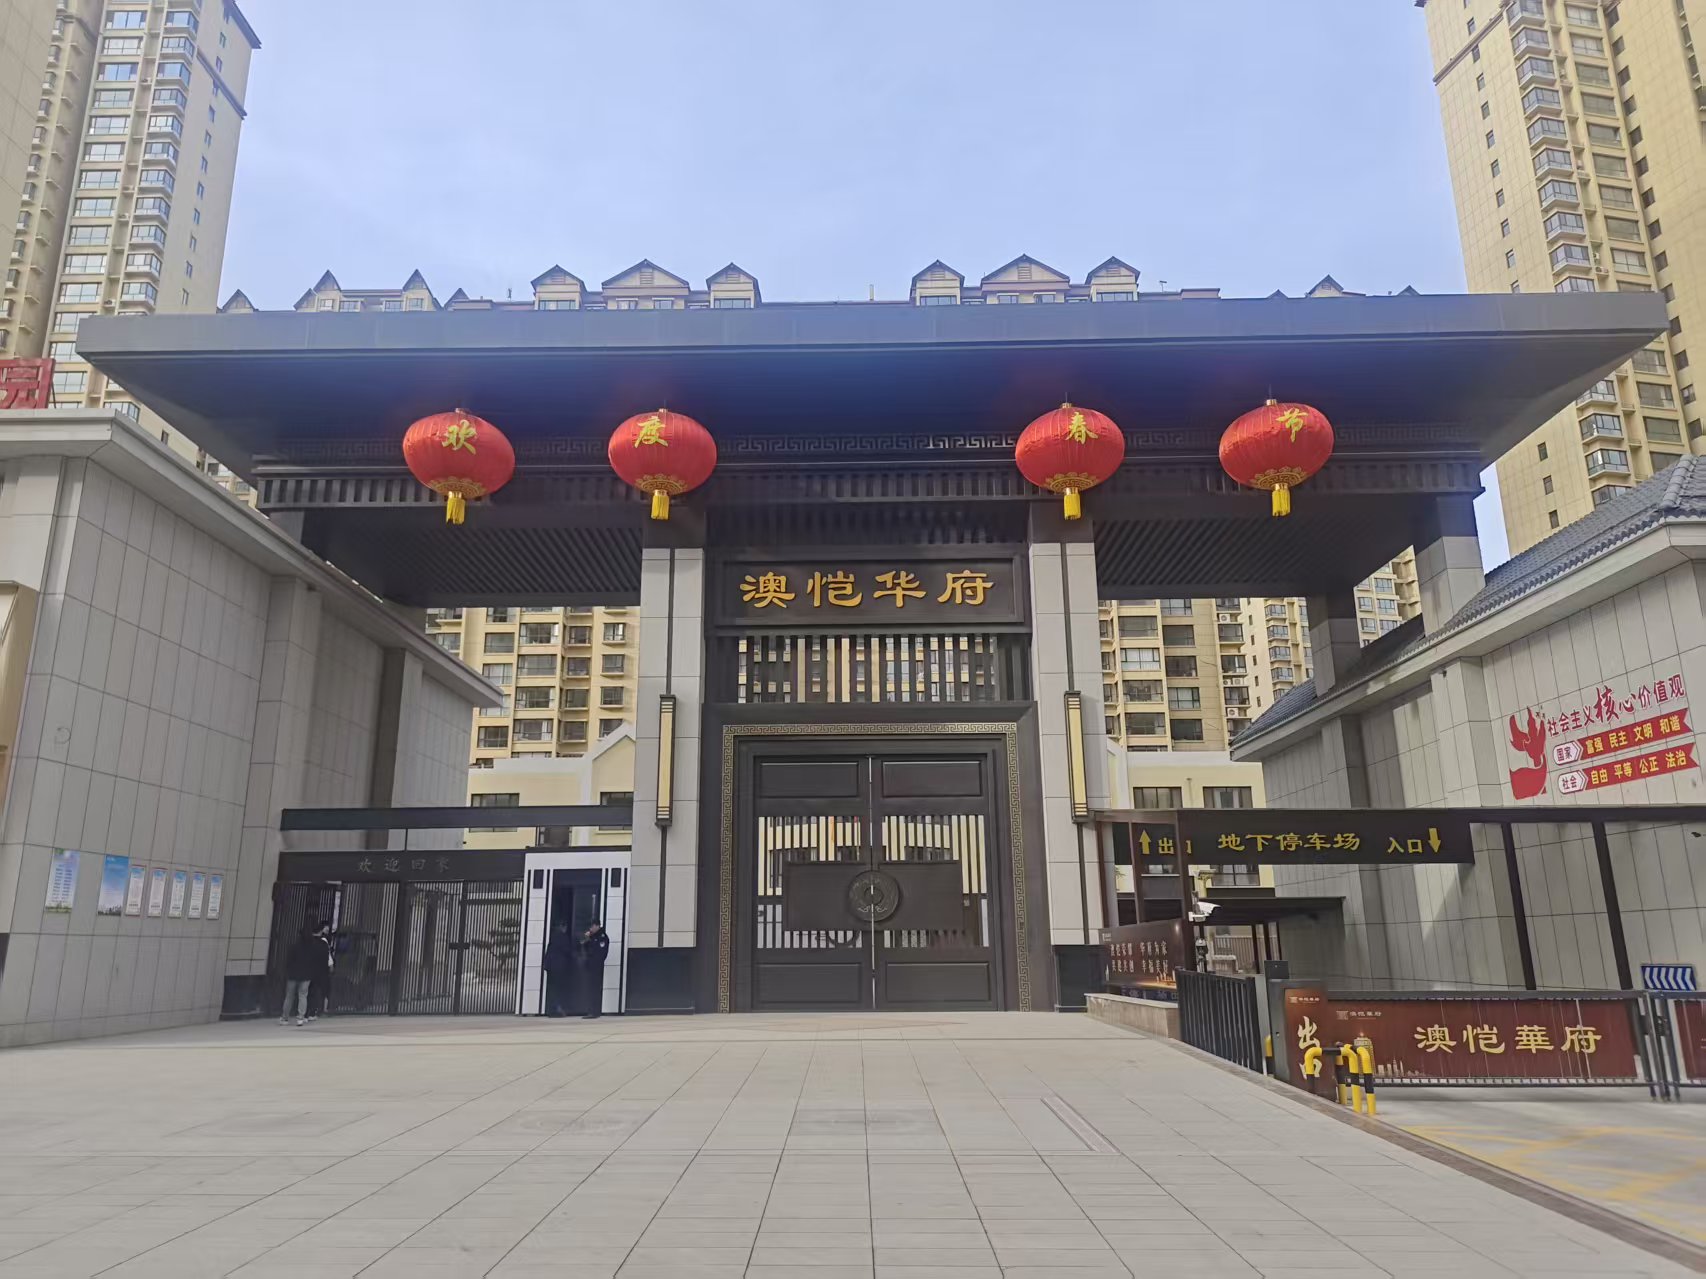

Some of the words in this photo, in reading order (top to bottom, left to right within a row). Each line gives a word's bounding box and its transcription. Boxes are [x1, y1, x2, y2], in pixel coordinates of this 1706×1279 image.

[441, 420, 477, 455] 欢
[634, 415, 669, 448] 度
[1066, 411, 1098, 444] 春
[1276, 407, 1308, 443] 节
[739, 569, 994, 609] 澳恺华府
[1548, 674, 1685, 736] 社会主义核心价值观
[1556, 746, 1572, 761] 国家
[1585, 737, 1604, 754] 富强
[1609, 731, 1628, 748] 民主
[1634, 723, 1653, 742] 文明
[1660, 715, 1681, 735] 和谐
[1561, 776, 1577, 790] 社会
[1590, 769, 1608, 785] 自由
[1614, 762, 1633, 778] 平等
[1639, 756, 1659, 774] 公正
[1665, 750, 1687, 769] 法治
[1217, 833, 1361, 851] 地下停车场
[1387, 837, 1423, 854] 入口
[1414, 1023, 1602, 1054] 澳恺華府
